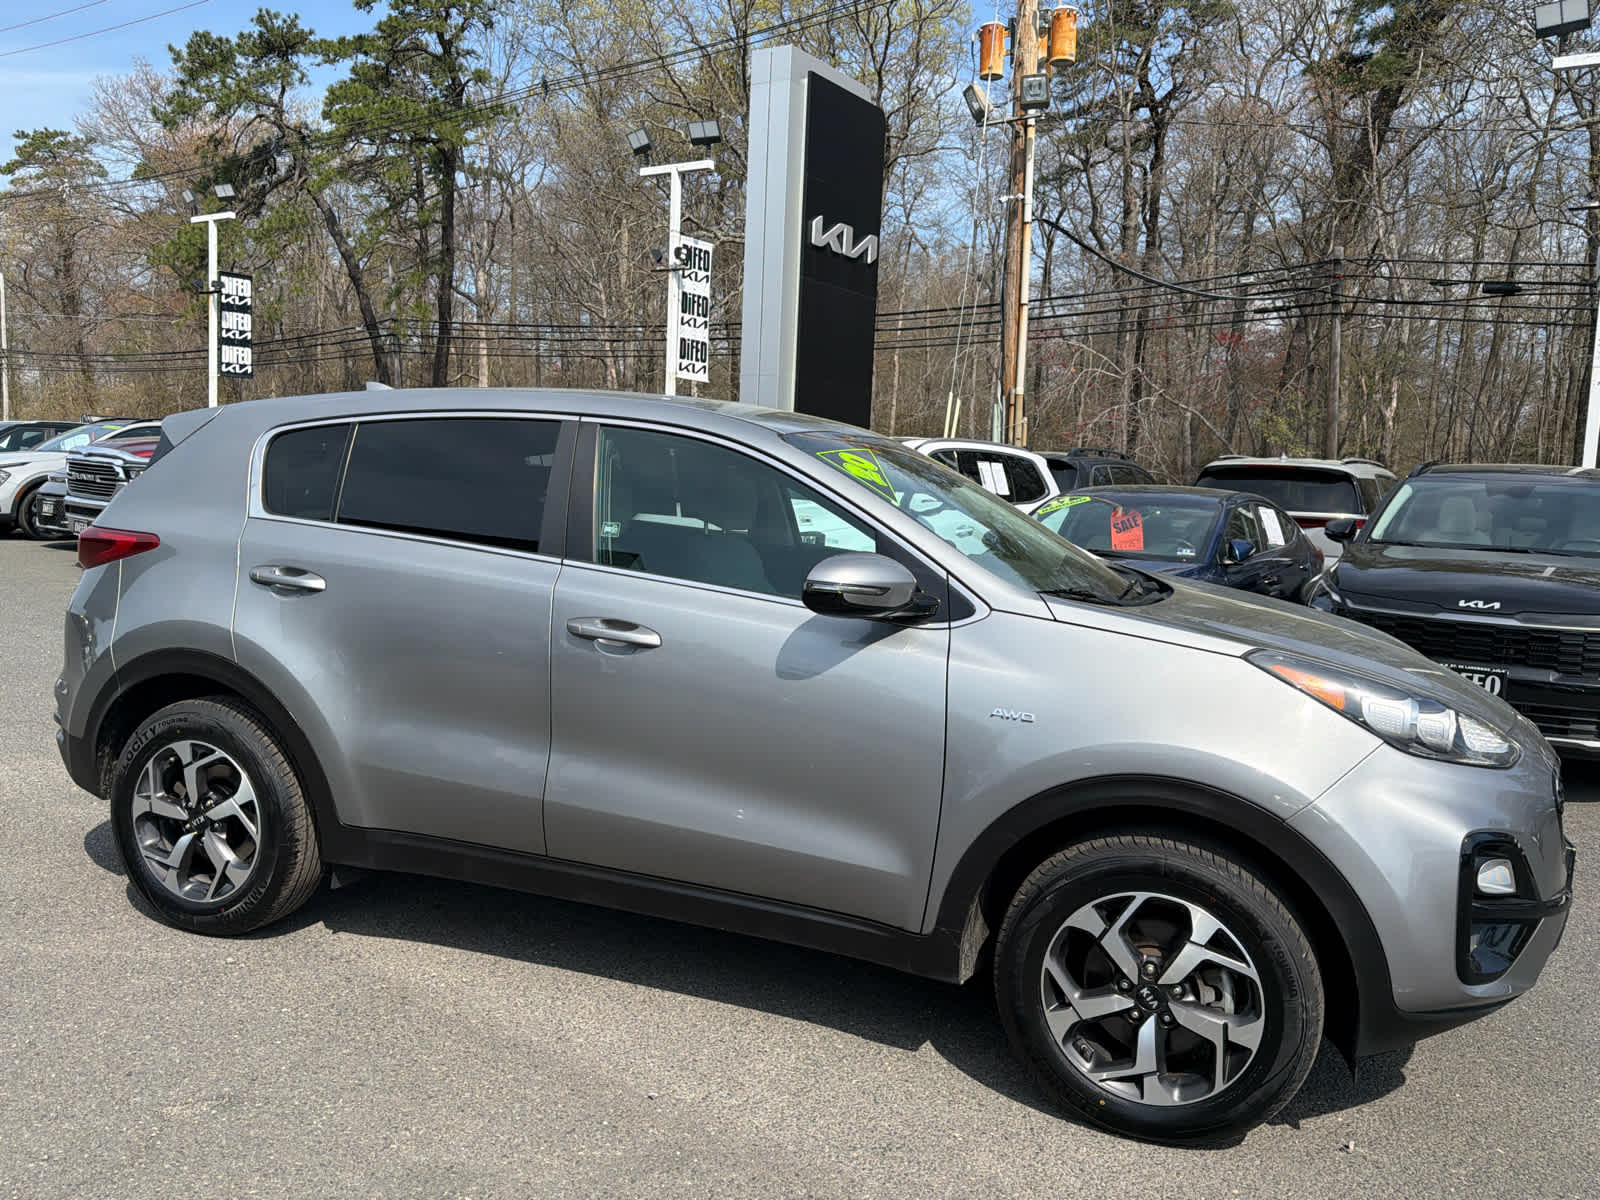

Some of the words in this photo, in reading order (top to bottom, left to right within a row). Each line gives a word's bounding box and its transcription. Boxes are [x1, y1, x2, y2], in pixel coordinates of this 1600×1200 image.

[811, 215, 878, 264] KIA
[682, 270, 709, 283] KIA
[222, 295, 251, 305] KIA
[681, 316, 708, 330] KIA
[222, 329, 251, 340] KIA
[222, 363, 251, 374] KIA
[678, 362, 706, 374] KIA
[1113, 515, 1140, 534] SALE
[1458, 600, 1501, 609] KIA
[990, 708, 1034, 723] AWD
